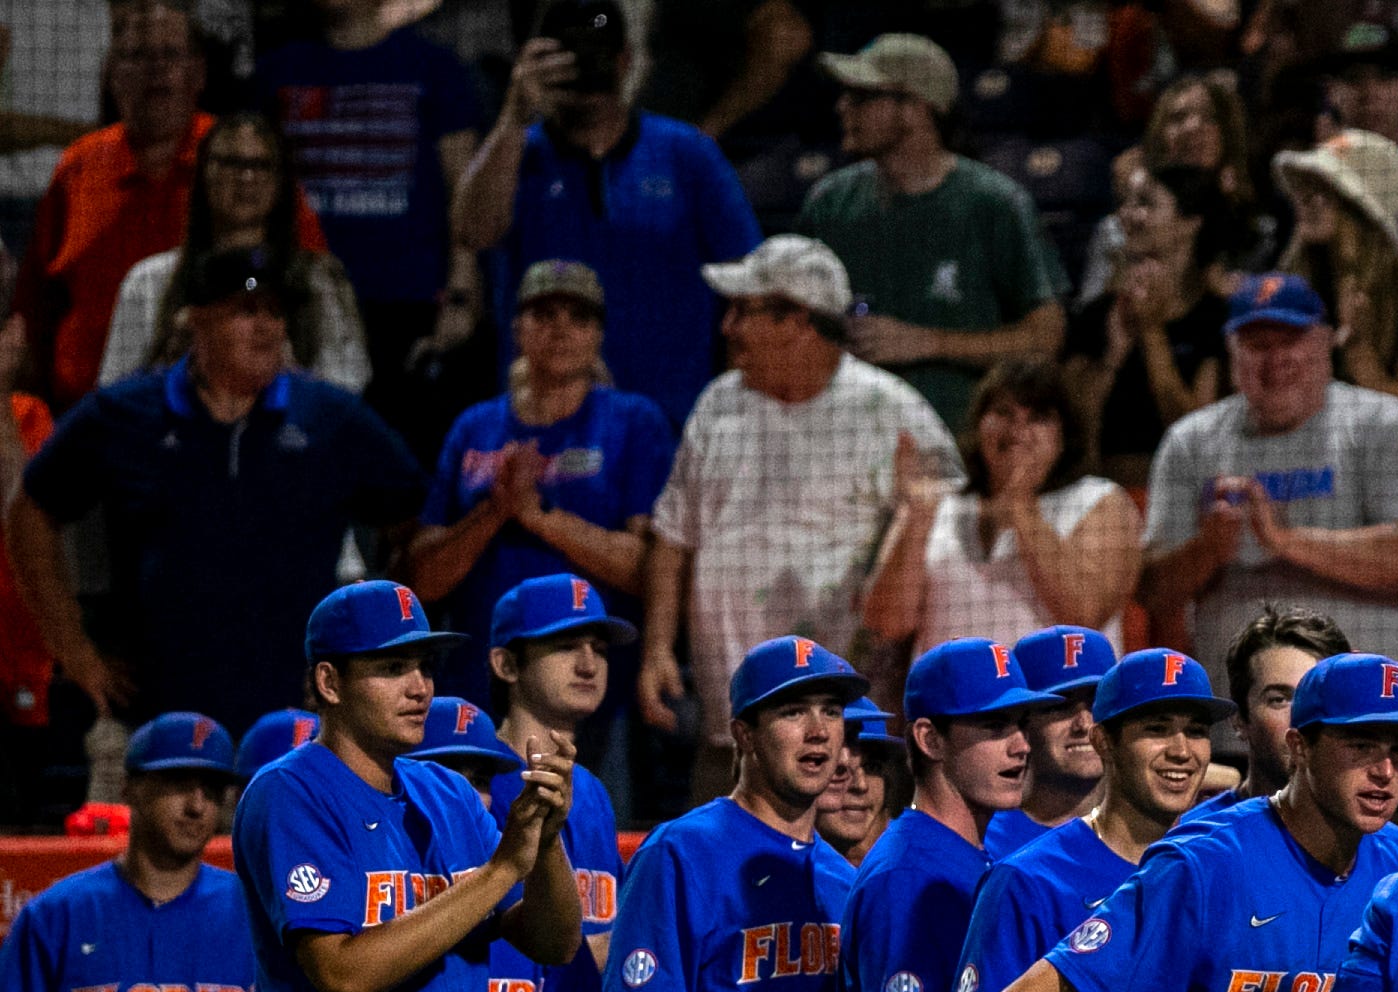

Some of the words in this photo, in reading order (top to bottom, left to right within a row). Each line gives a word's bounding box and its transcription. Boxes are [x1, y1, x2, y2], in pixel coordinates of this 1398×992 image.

[394, 585, 416, 621] F
[571, 577, 593, 612] F
[793, 638, 816, 669] F
[988, 642, 1011, 679] F
[1062, 633, 1086, 670] F
[1161, 653, 1186, 687] F
[454, 702, 478, 734] F
[289, 865, 320, 893] SEC
